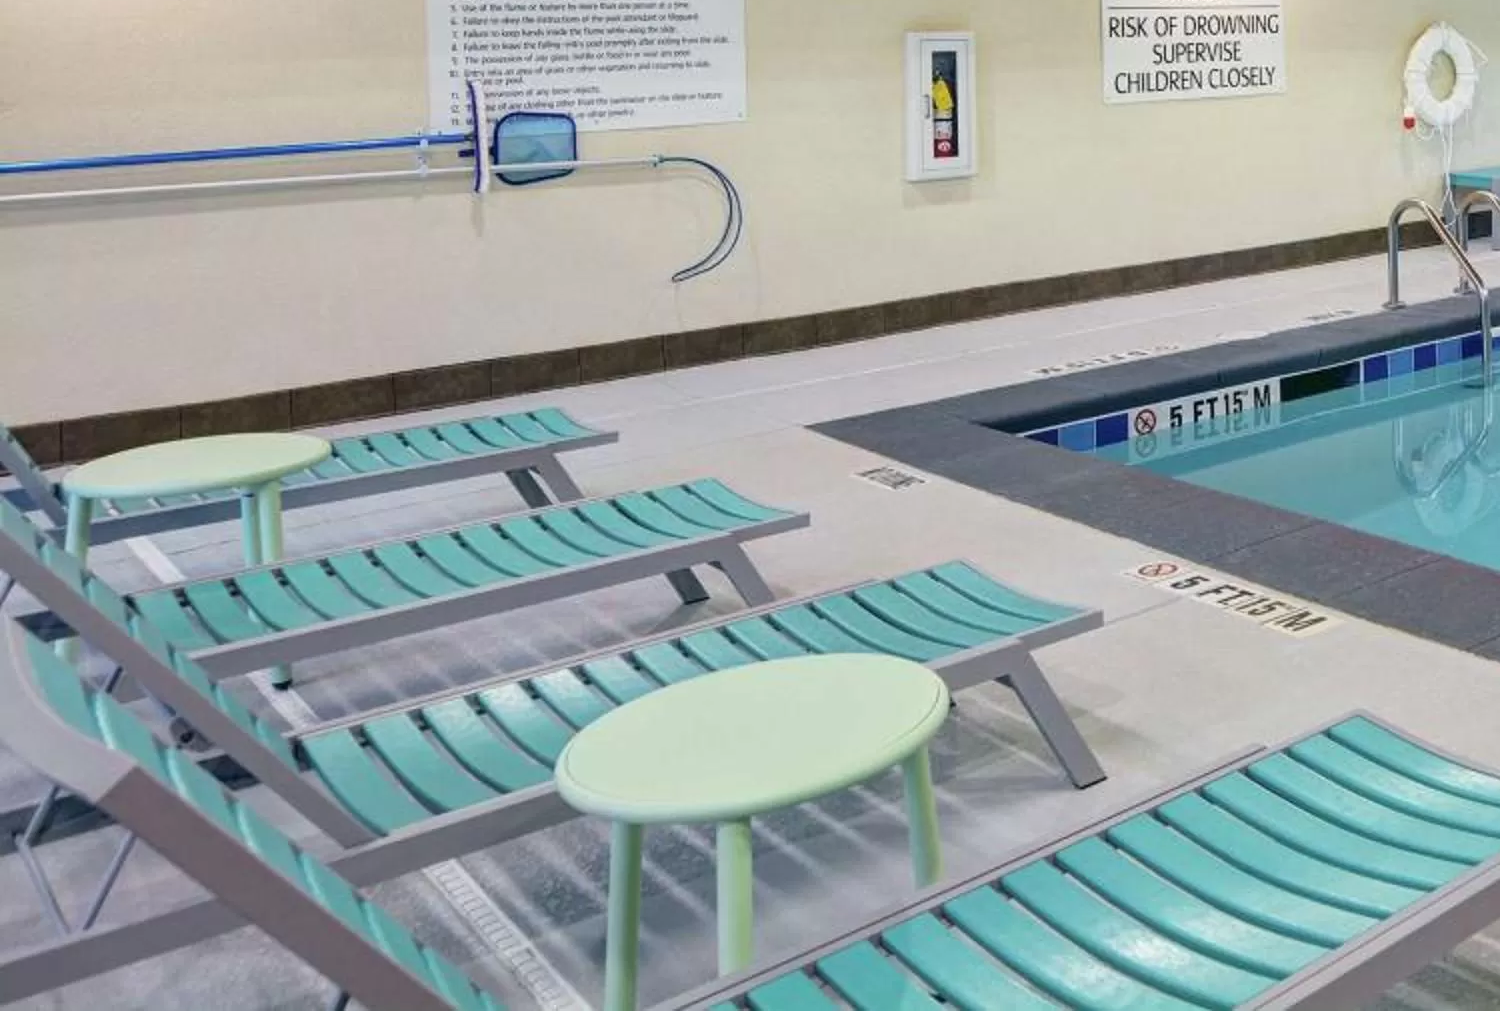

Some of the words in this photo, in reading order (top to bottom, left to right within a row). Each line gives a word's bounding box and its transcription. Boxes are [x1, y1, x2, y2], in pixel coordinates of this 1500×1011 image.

[1109, 16, 1149, 38] RISK
[1154, 16, 1179, 37] OF
[1183, 14, 1280, 36] DROWNING
[1152, 40, 1242, 65] SUPERVISE
[1114, 70, 1203, 94] CHILDREN
[1207, 66, 1276, 89] CLOSELY
[1169, 405, 1183, 428] 5
[1193, 397, 1219, 424] FT
[1253, 384, 1271, 409] M
[1169, 575, 1210, 590] 5
[1197, 583, 1255, 606] FT
